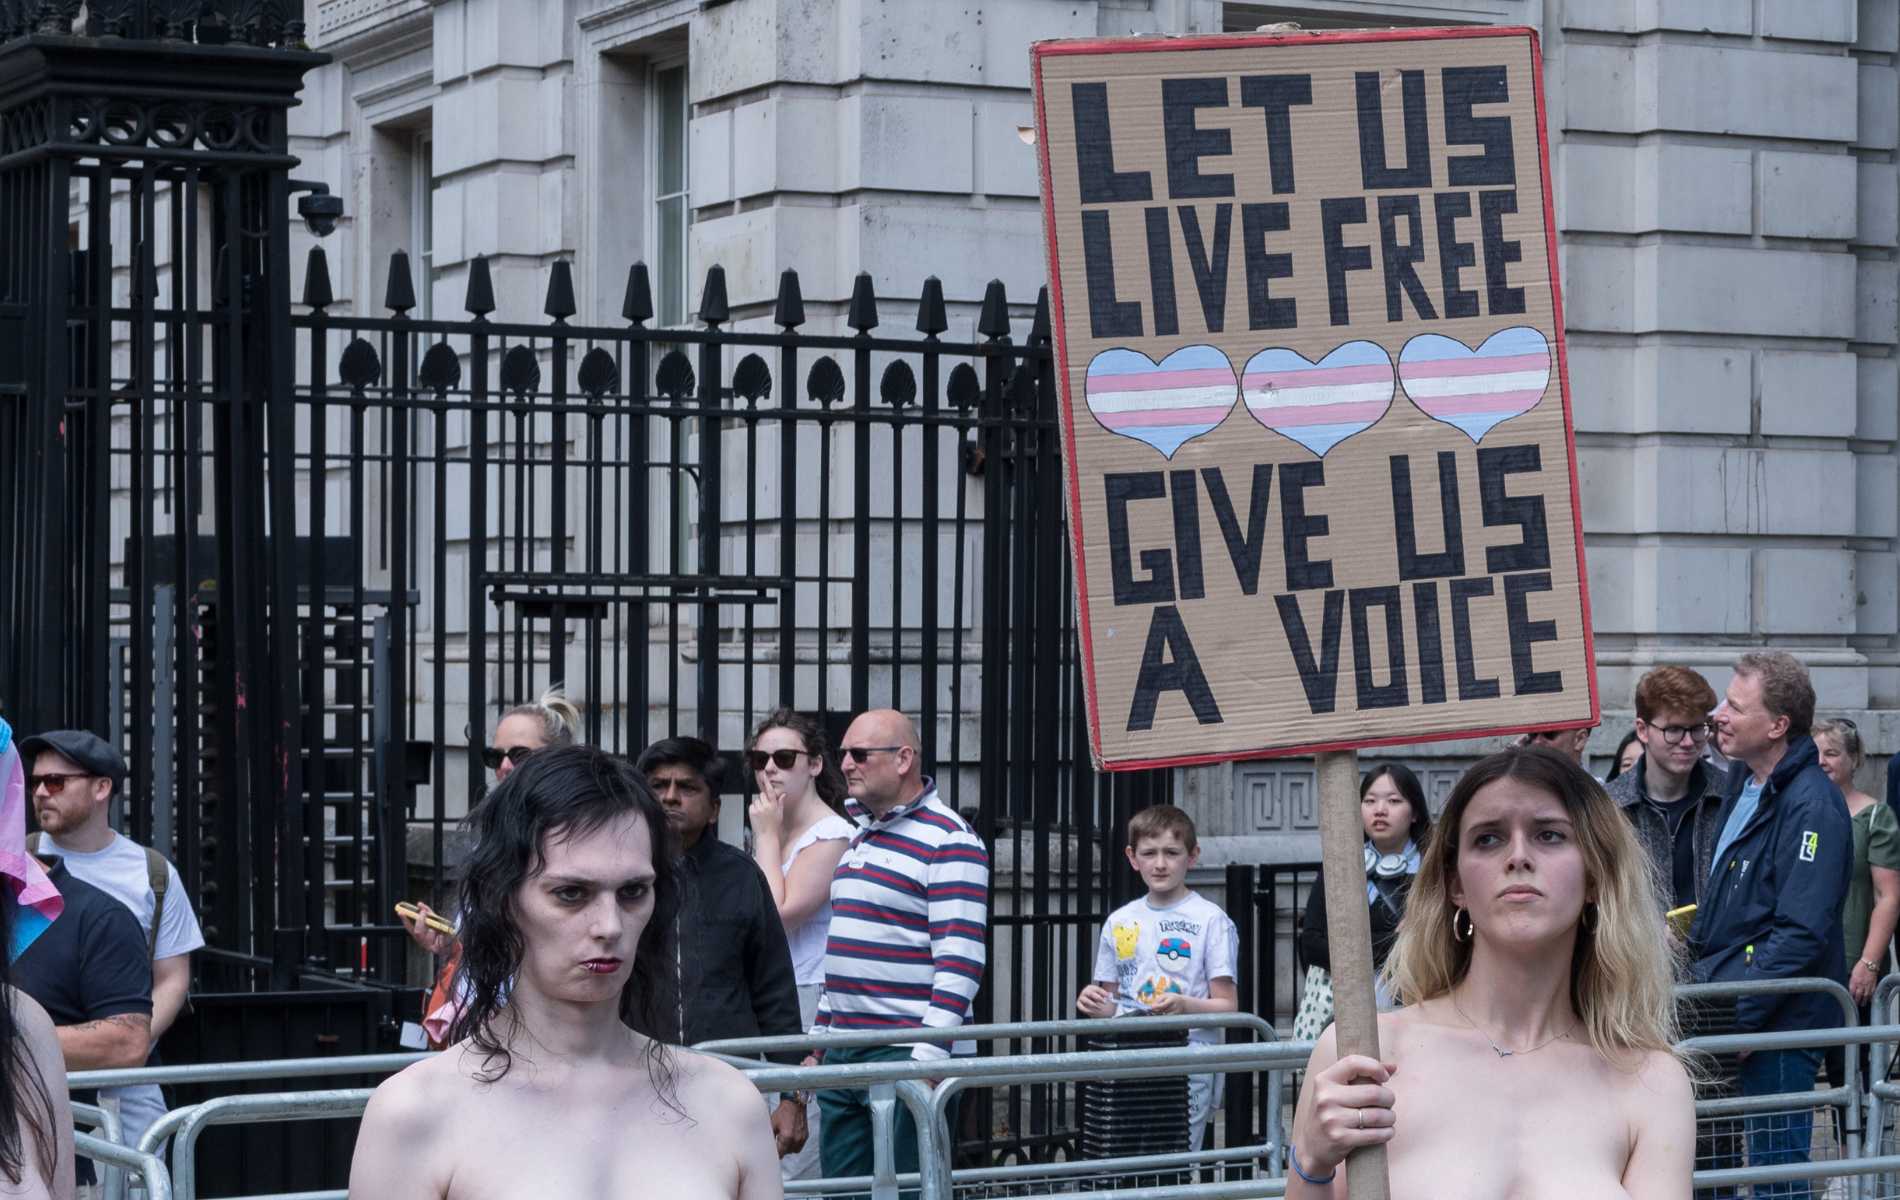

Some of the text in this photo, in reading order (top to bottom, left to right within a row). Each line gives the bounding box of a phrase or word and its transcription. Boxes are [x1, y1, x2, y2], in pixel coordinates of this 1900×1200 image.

[1071, 65, 1517, 204] LET US
[1081, 190, 1526, 339] LIVE FREE
[1104, 444, 1552, 606] GIVE US
[1126, 572, 1563, 732] A VOICE
